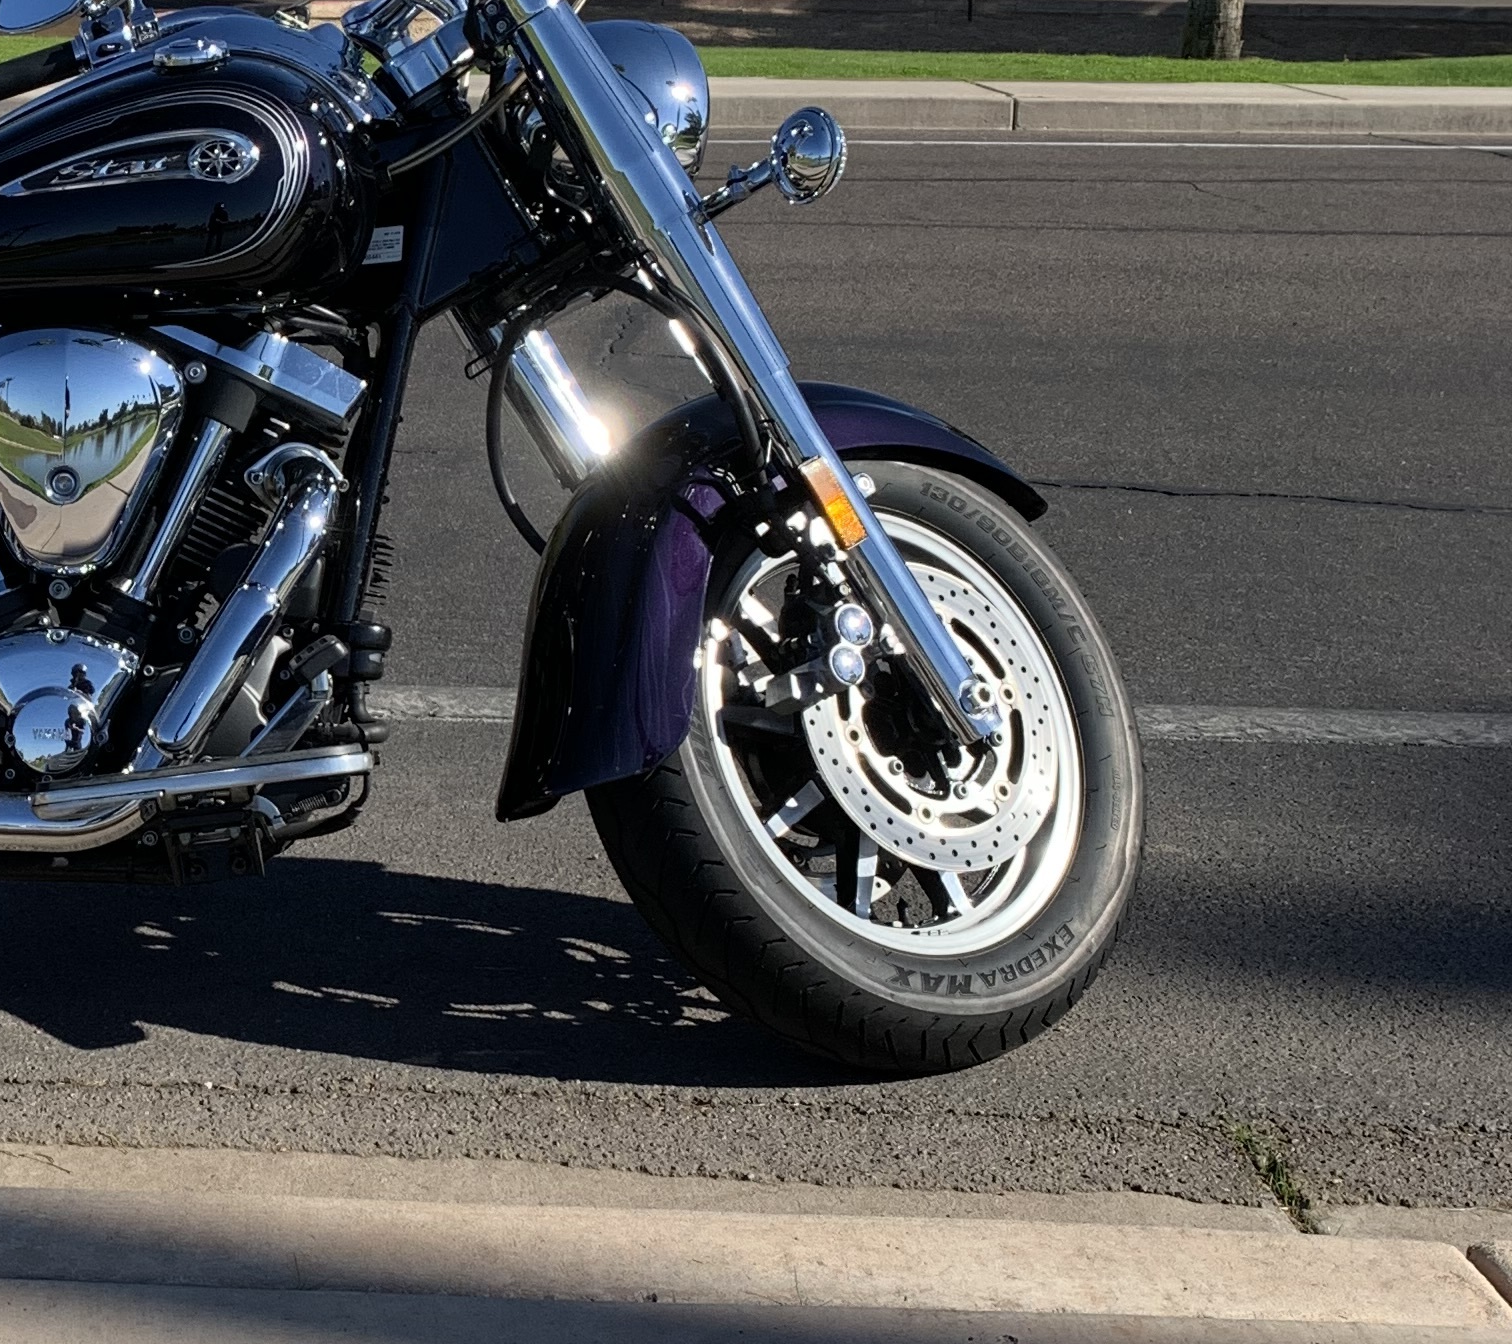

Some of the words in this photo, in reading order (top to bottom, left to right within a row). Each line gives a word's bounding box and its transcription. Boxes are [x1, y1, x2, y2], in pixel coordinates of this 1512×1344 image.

[50, 155, 179, 184] Star
[976, 919, 1076, 989] EXEDRA
[882, 961, 978, 996] MAX
